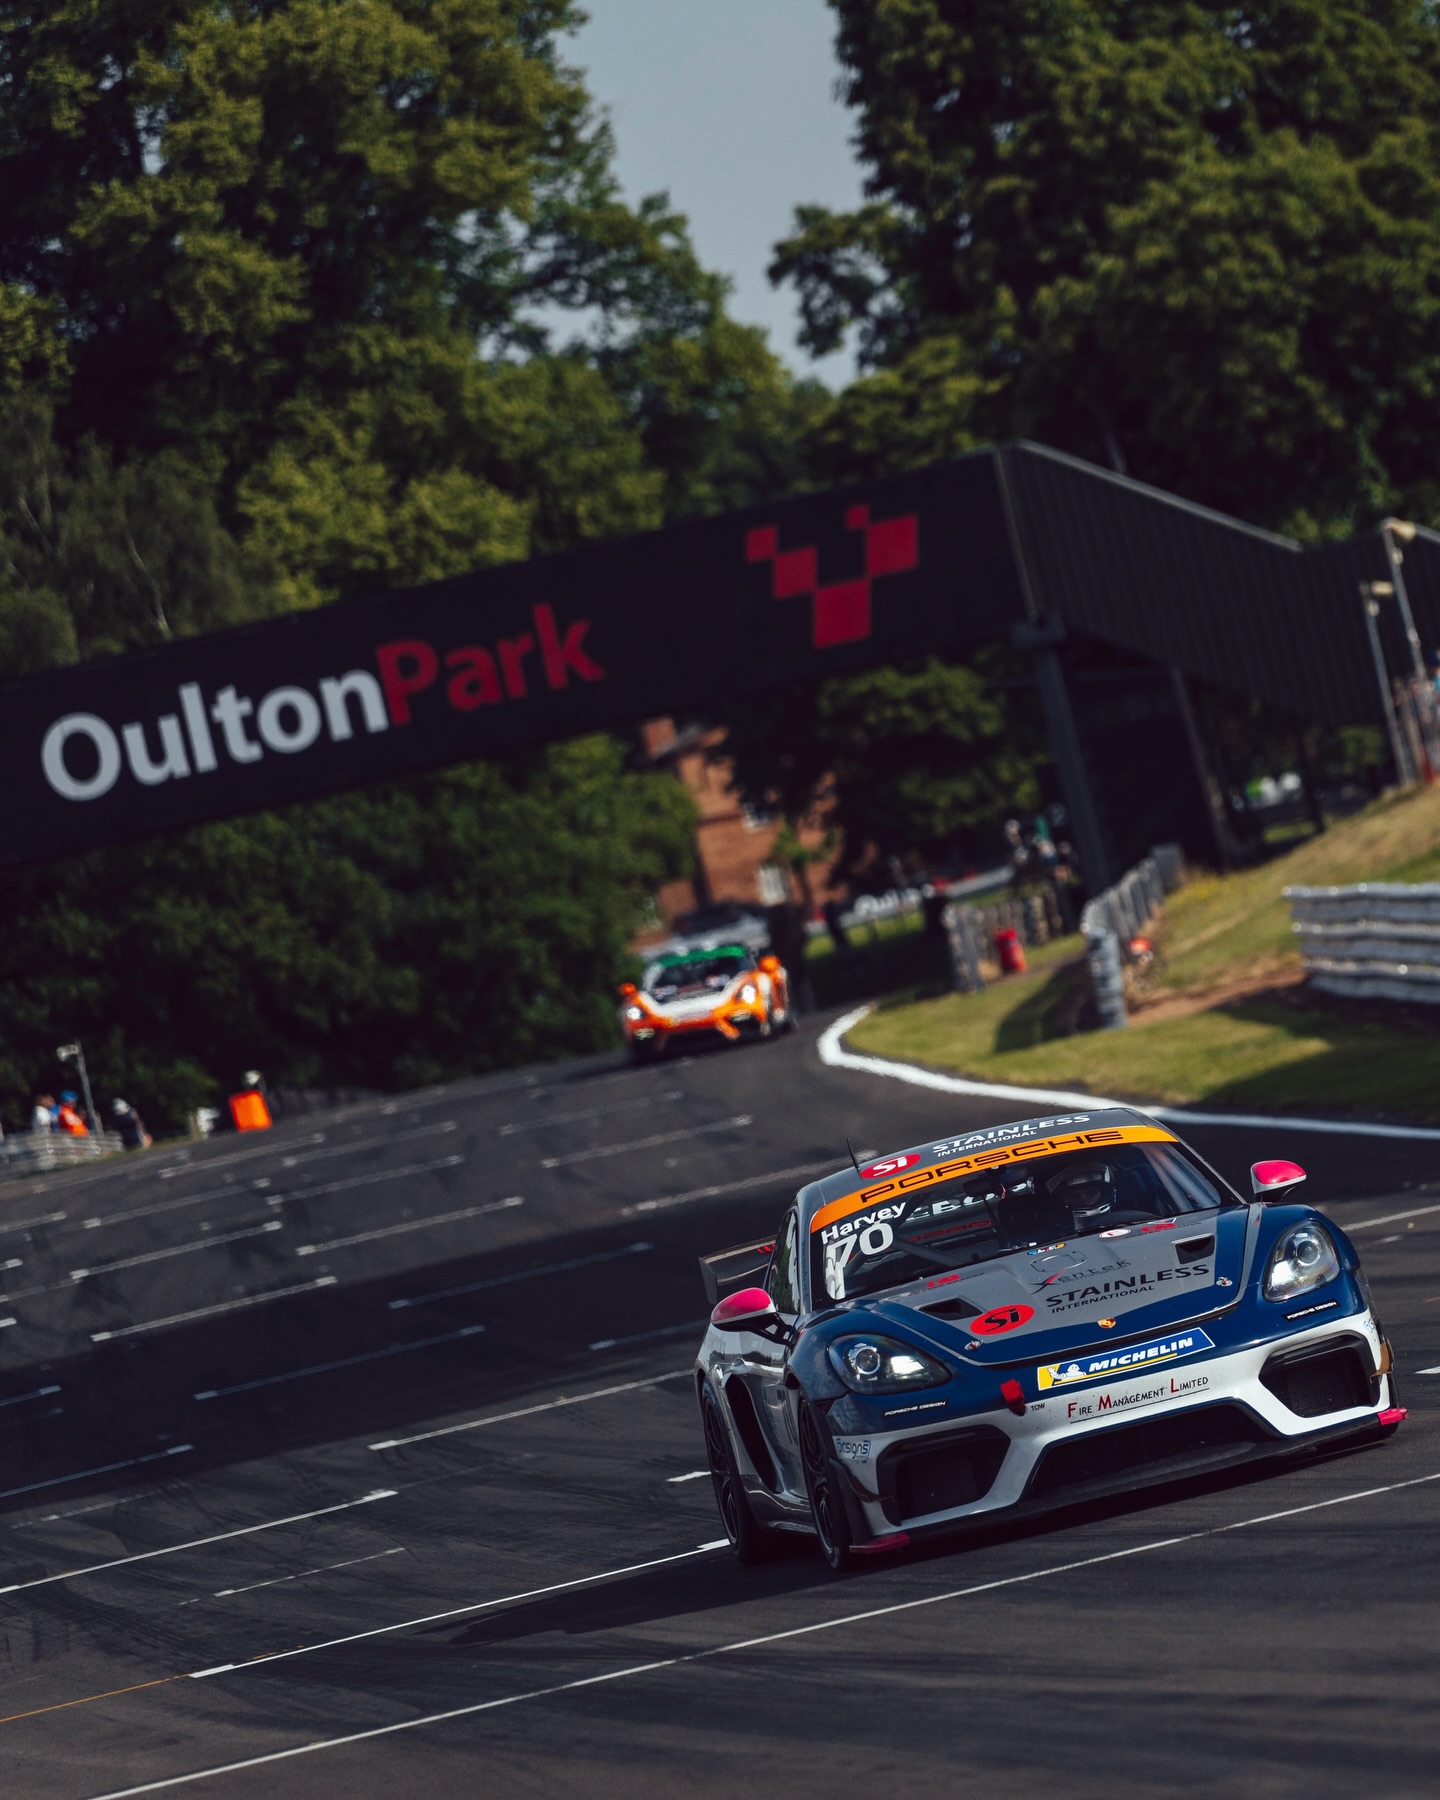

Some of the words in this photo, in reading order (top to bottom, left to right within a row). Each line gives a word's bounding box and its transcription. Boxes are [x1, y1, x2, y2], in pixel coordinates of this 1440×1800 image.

[932, 1114, 1091, 1154] STAINLESS
[937, 1130, 1038, 1157] INTERNATIONAL
[860, 1131, 1124, 1203] PORSCHE
[821, 1201, 907, 1244] Harvey
[829, 1221, 894, 1276] 70
[1046, 1264, 1210, 1308] STAINLESS
[1052, 1286, 1156, 1314] INTERNATIONAL
[1089, 1337, 1194, 1372] MICHELIN
[884, 1405, 918, 1416] PORSCHE
[919, 1401, 946, 1410] DESIGN
[1030, 1402, 1046, 1412] TOW
